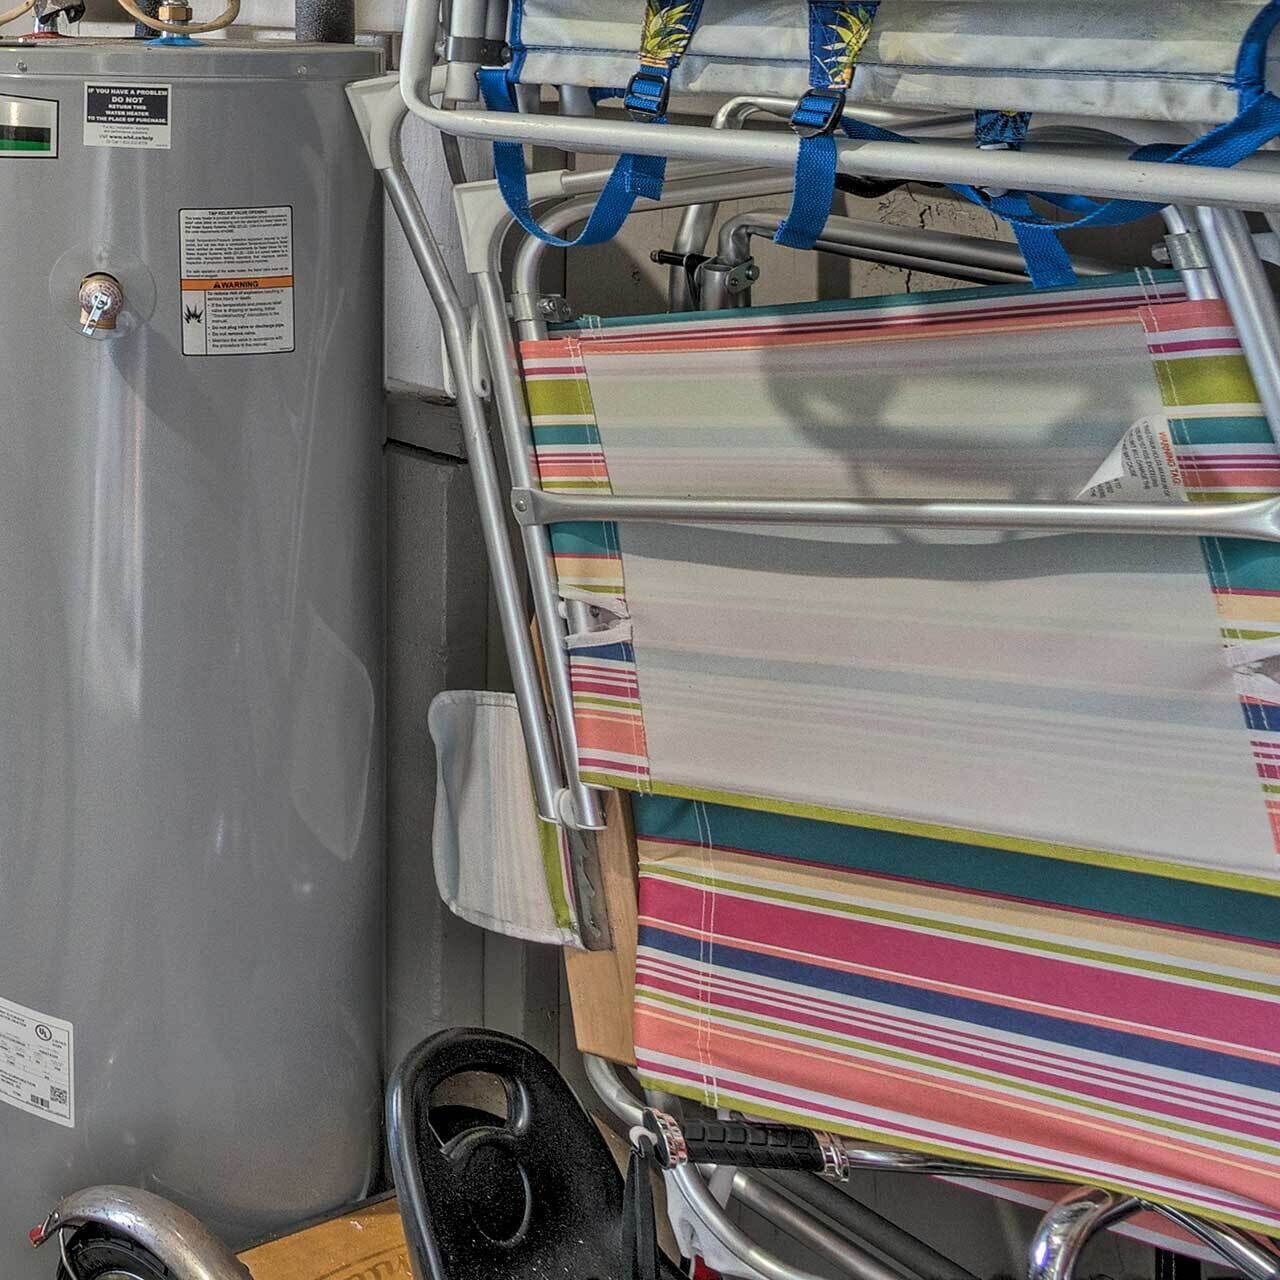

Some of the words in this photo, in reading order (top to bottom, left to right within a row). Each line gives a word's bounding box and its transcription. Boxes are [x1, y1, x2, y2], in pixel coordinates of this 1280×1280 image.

[125, 96, 144, 104] NOT
[221, 280, 259, 288] WARNING
[1158, 432, 1176, 470] WARNING
